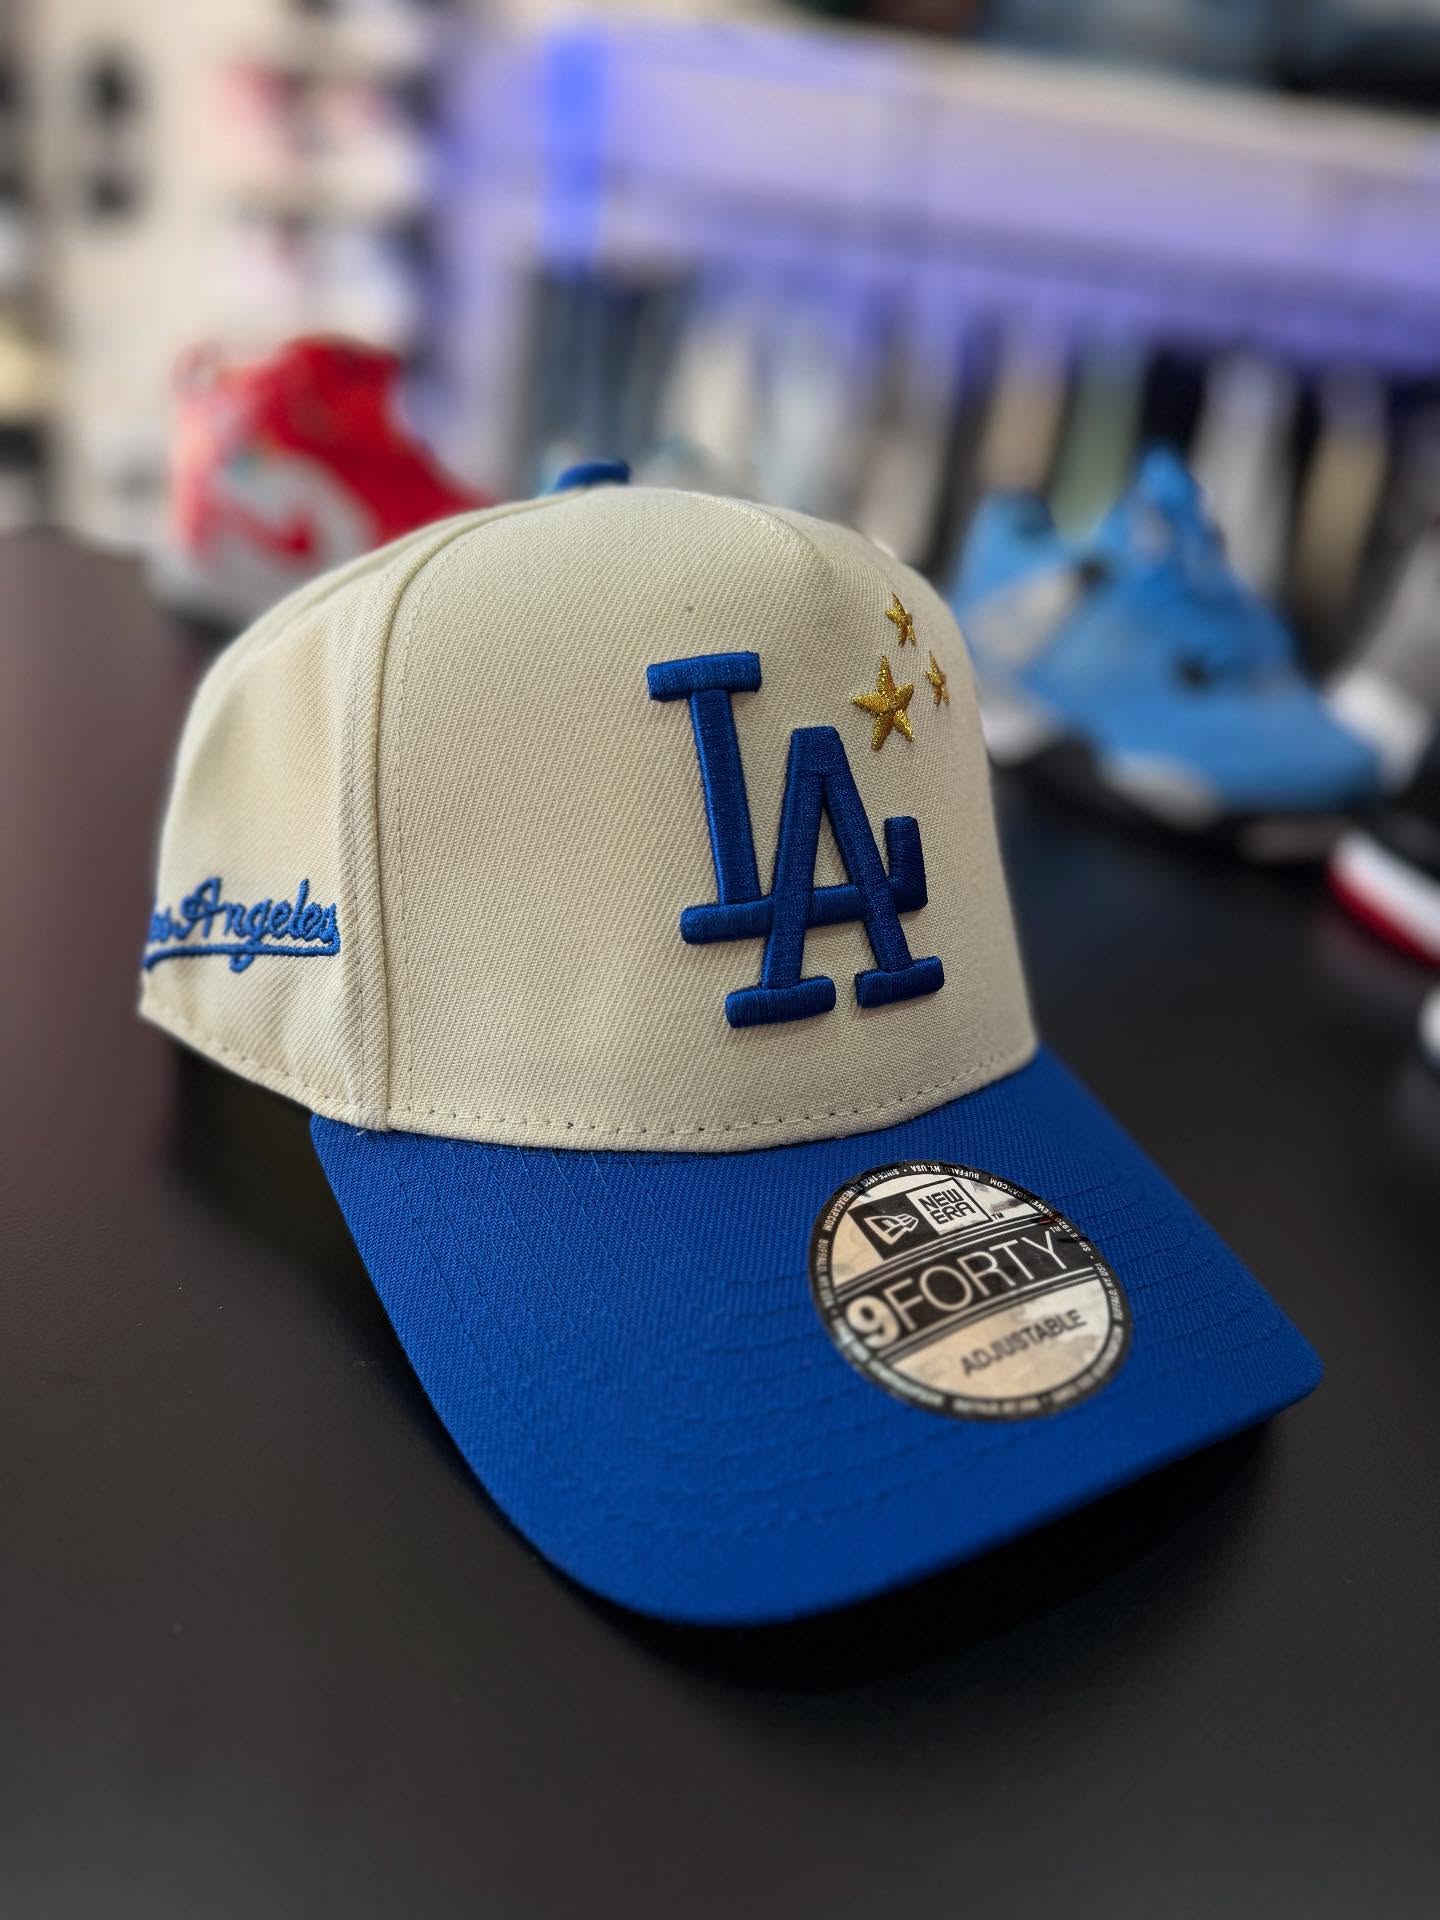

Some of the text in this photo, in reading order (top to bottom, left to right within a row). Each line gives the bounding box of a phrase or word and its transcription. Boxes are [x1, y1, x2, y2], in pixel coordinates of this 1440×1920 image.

[647, 650, 945, 1029] LA
[180, 876, 341, 974] Angeles
[918, 1188, 976, 1225] NEW ERA
[845, 1229, 1067, 1348] 9FORTY
[959, 1308, 1087, 1376] ADJUSTABLE
